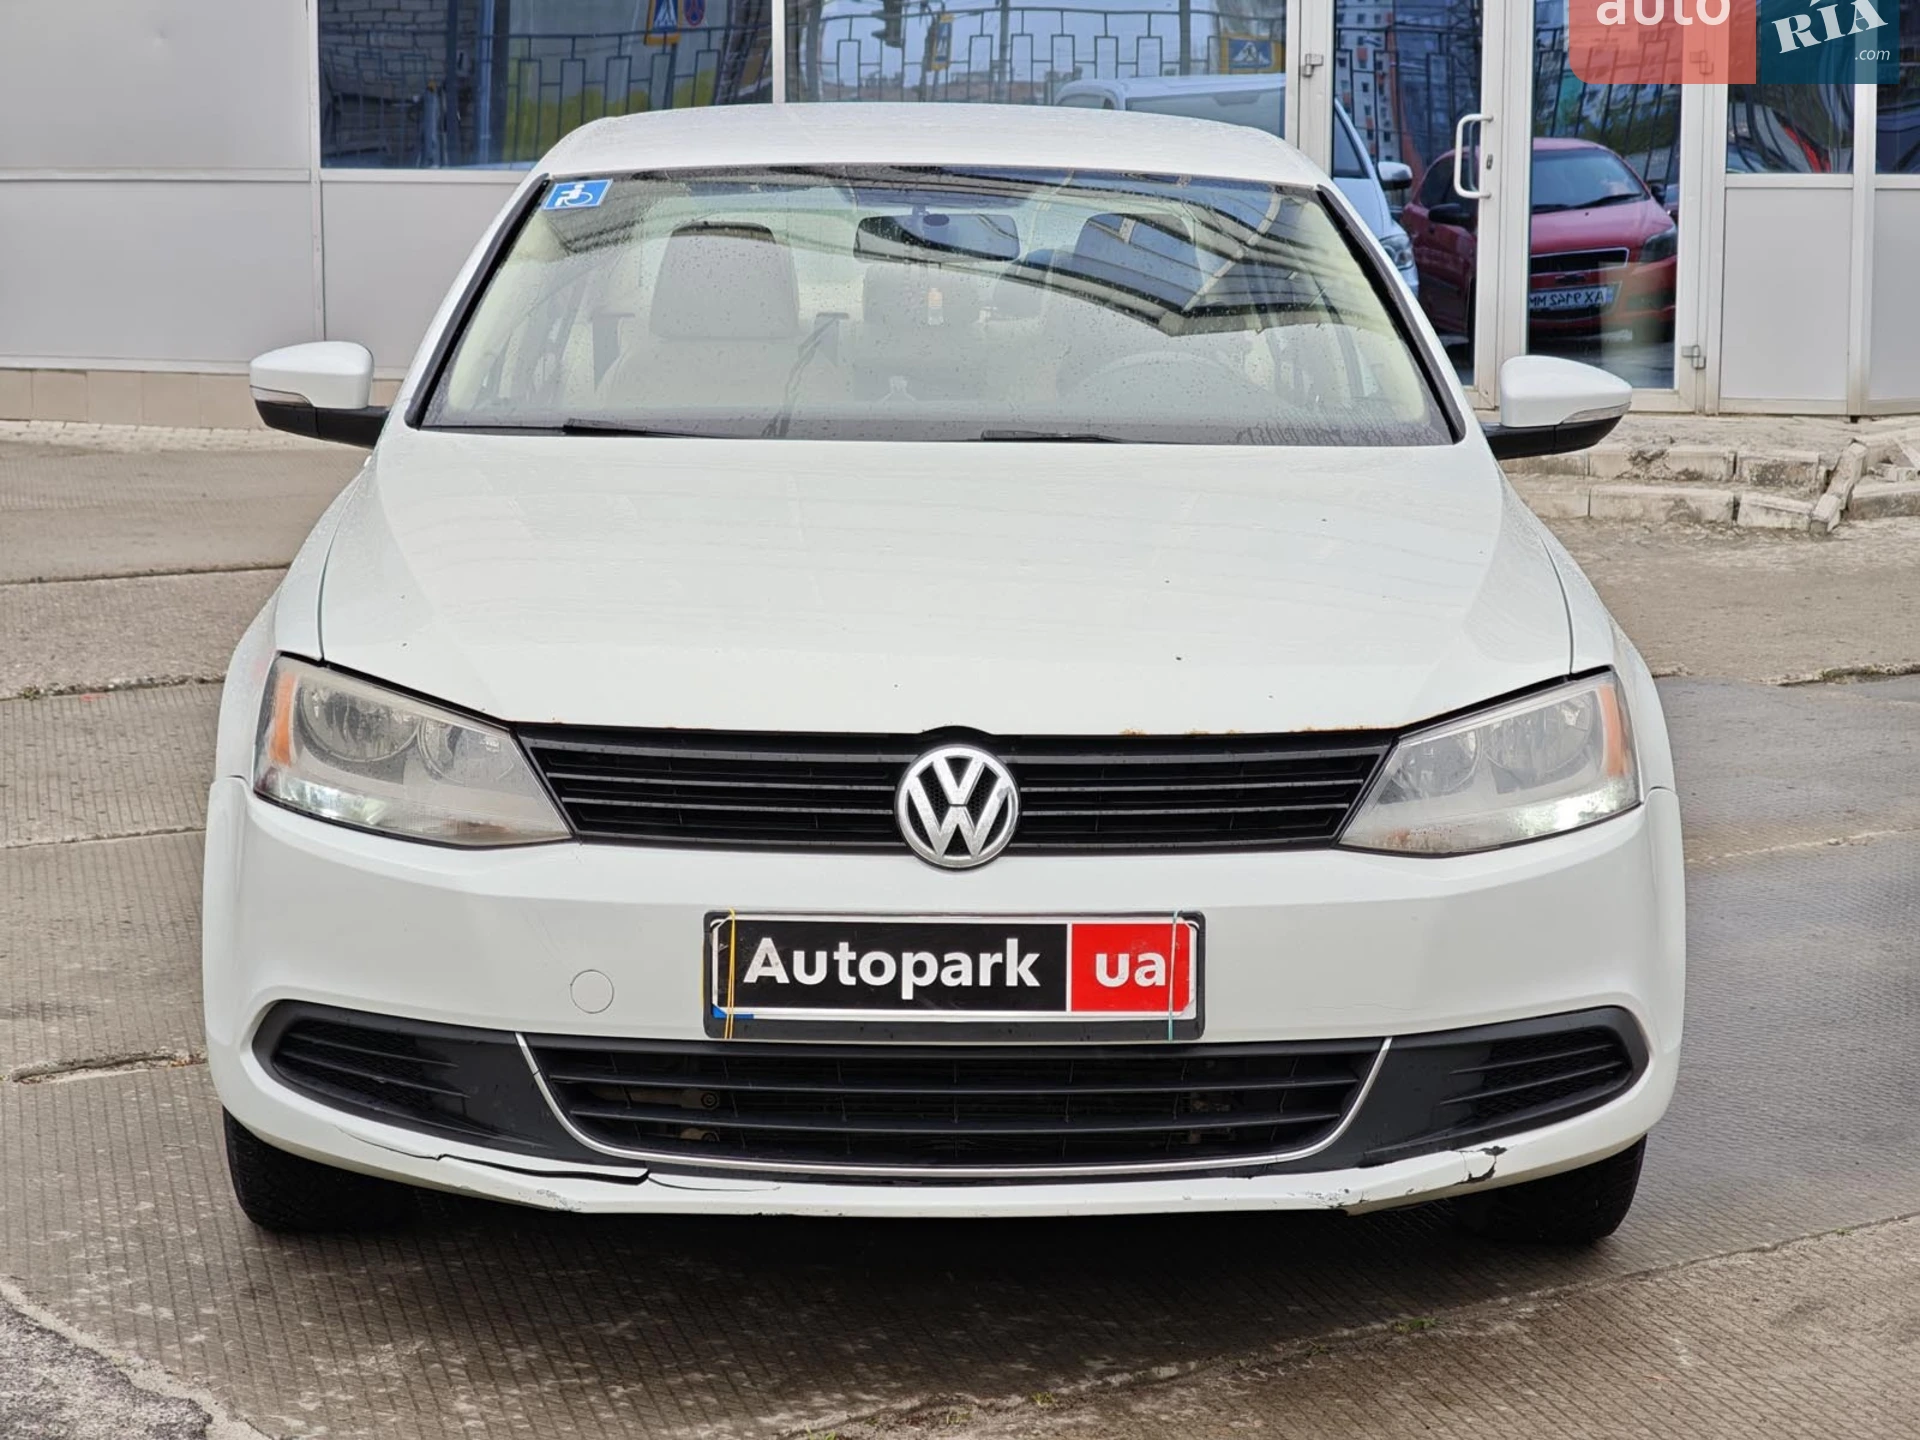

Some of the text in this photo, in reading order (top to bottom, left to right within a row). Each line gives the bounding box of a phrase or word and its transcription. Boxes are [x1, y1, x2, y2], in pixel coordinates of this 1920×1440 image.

[898, 746, 1016, 867] VW
[743, 937, 1166, 1000] Autopark ua
